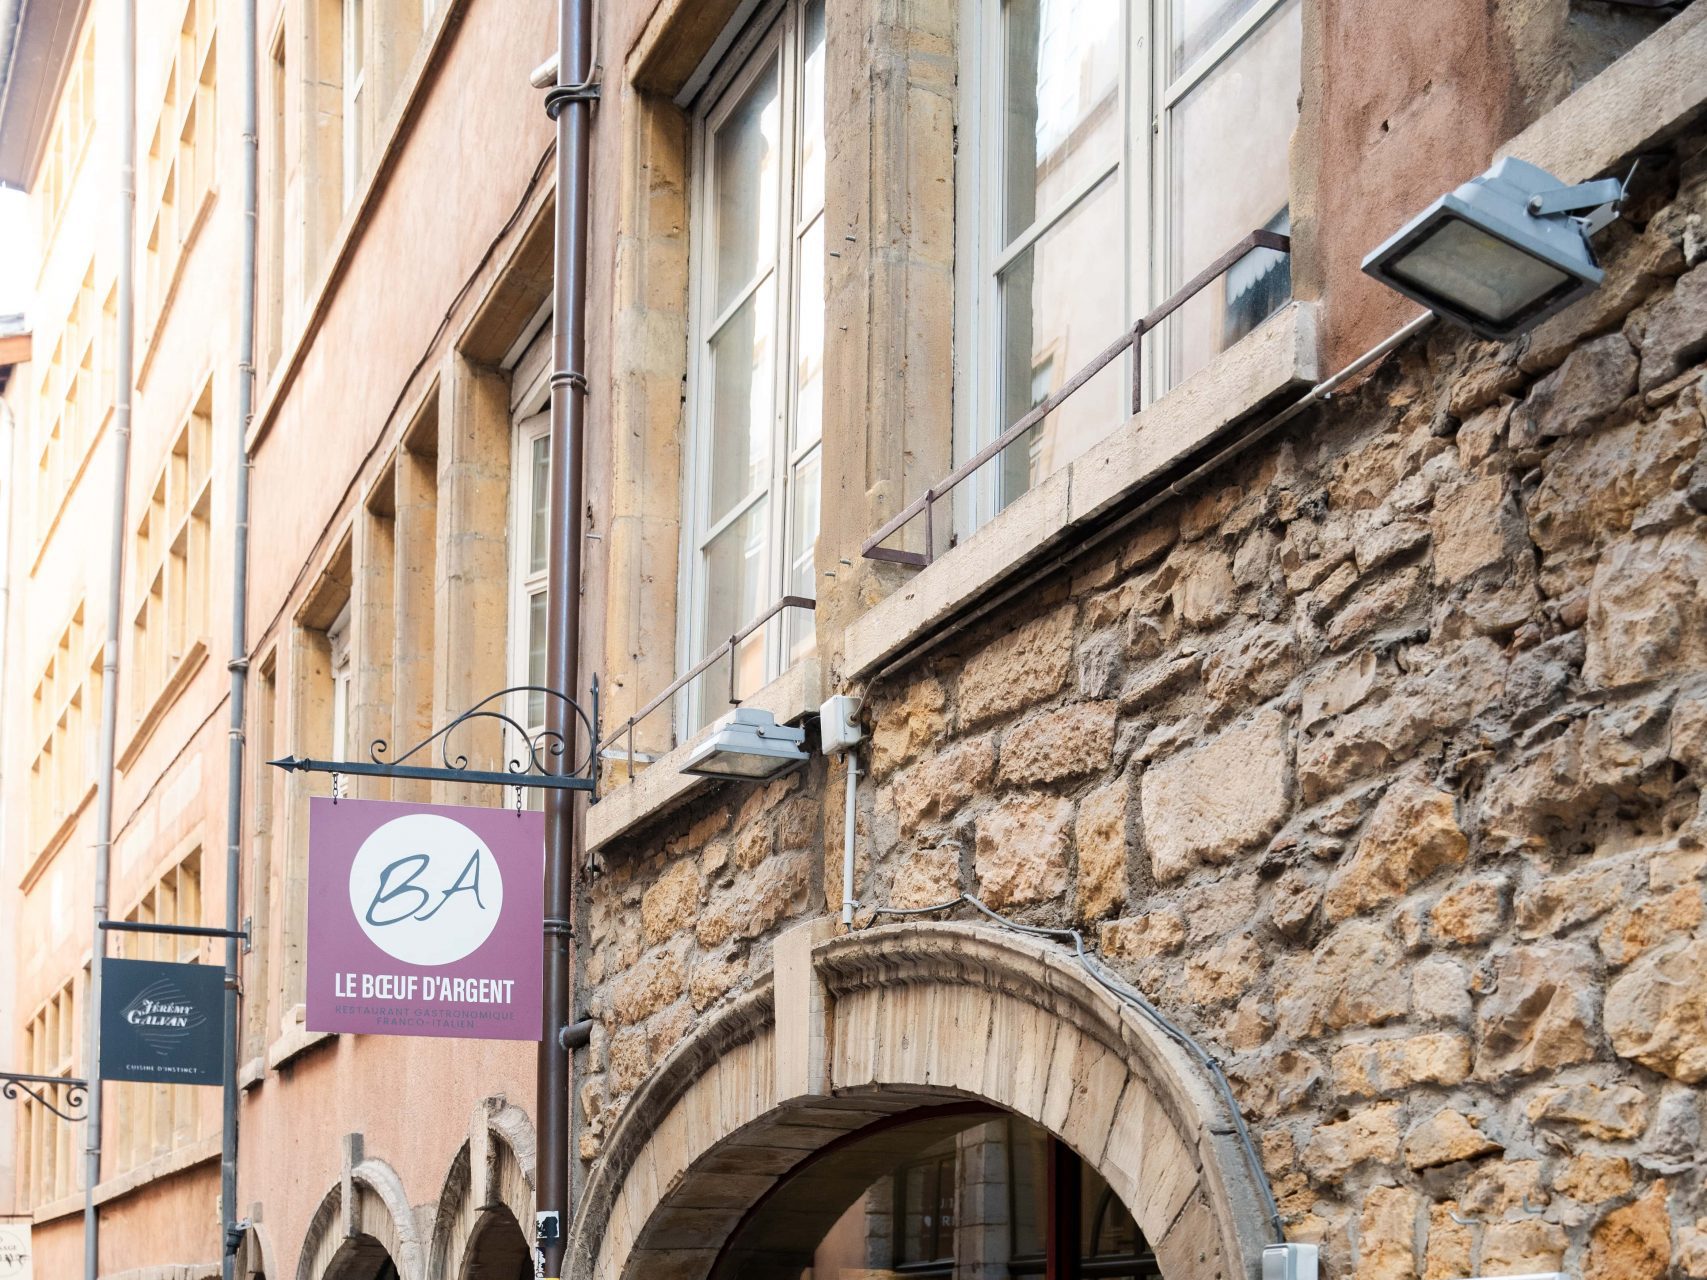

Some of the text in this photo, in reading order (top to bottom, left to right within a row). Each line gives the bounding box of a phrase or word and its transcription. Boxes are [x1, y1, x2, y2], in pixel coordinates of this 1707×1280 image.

[366, 849, 487, 927] BA
[335, 972, 515, 1004] LE BŒUF D'ARGENT
[142, 999, 193, 1015] JÉRÉMY
[335, 1005, 516, 1021] RESTAURANT GASTRONOMIQUE
[127, 1010, 188, 1028] GALVAN
[376, 1016, 475, 1029] FRANCO-ITALIEN
[126, 1064, 198, 1074] CUISINE D'INSTINCT
